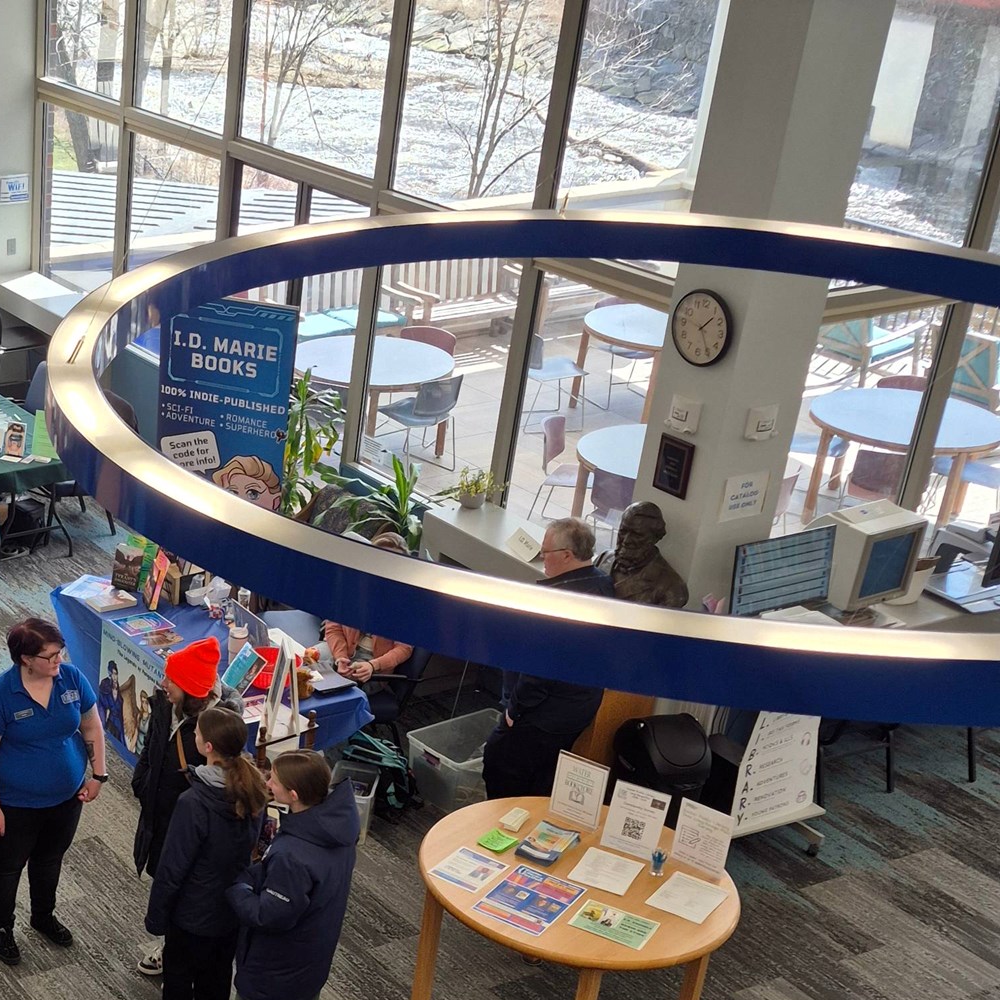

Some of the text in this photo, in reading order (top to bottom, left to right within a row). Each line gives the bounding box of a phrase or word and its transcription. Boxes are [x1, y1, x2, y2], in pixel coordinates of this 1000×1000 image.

[174, 330, 278, 362] I.D. MARIE
[191, 353, 257, 378] BOOKS
[160, 385, 286, 415] 100% INDIE-PUBLISHED
[166, 403, 194, 414] SCI-FI
[166, 412, 216, 428] ADVENTURE
[226, 414, 268, 428] ROMANCE
[226, 422, 276, 439] SUPERHERO
[169, 437, 208, 450] Scan the
[173, 448, 209, 460] code for
[178, 456, 216, 468] ore info!
[730, 490, 759, 501] CATALOG
[741, 500, 757, 508] ONLY
[103, 629, 140, 661] MIND-BLOWING
